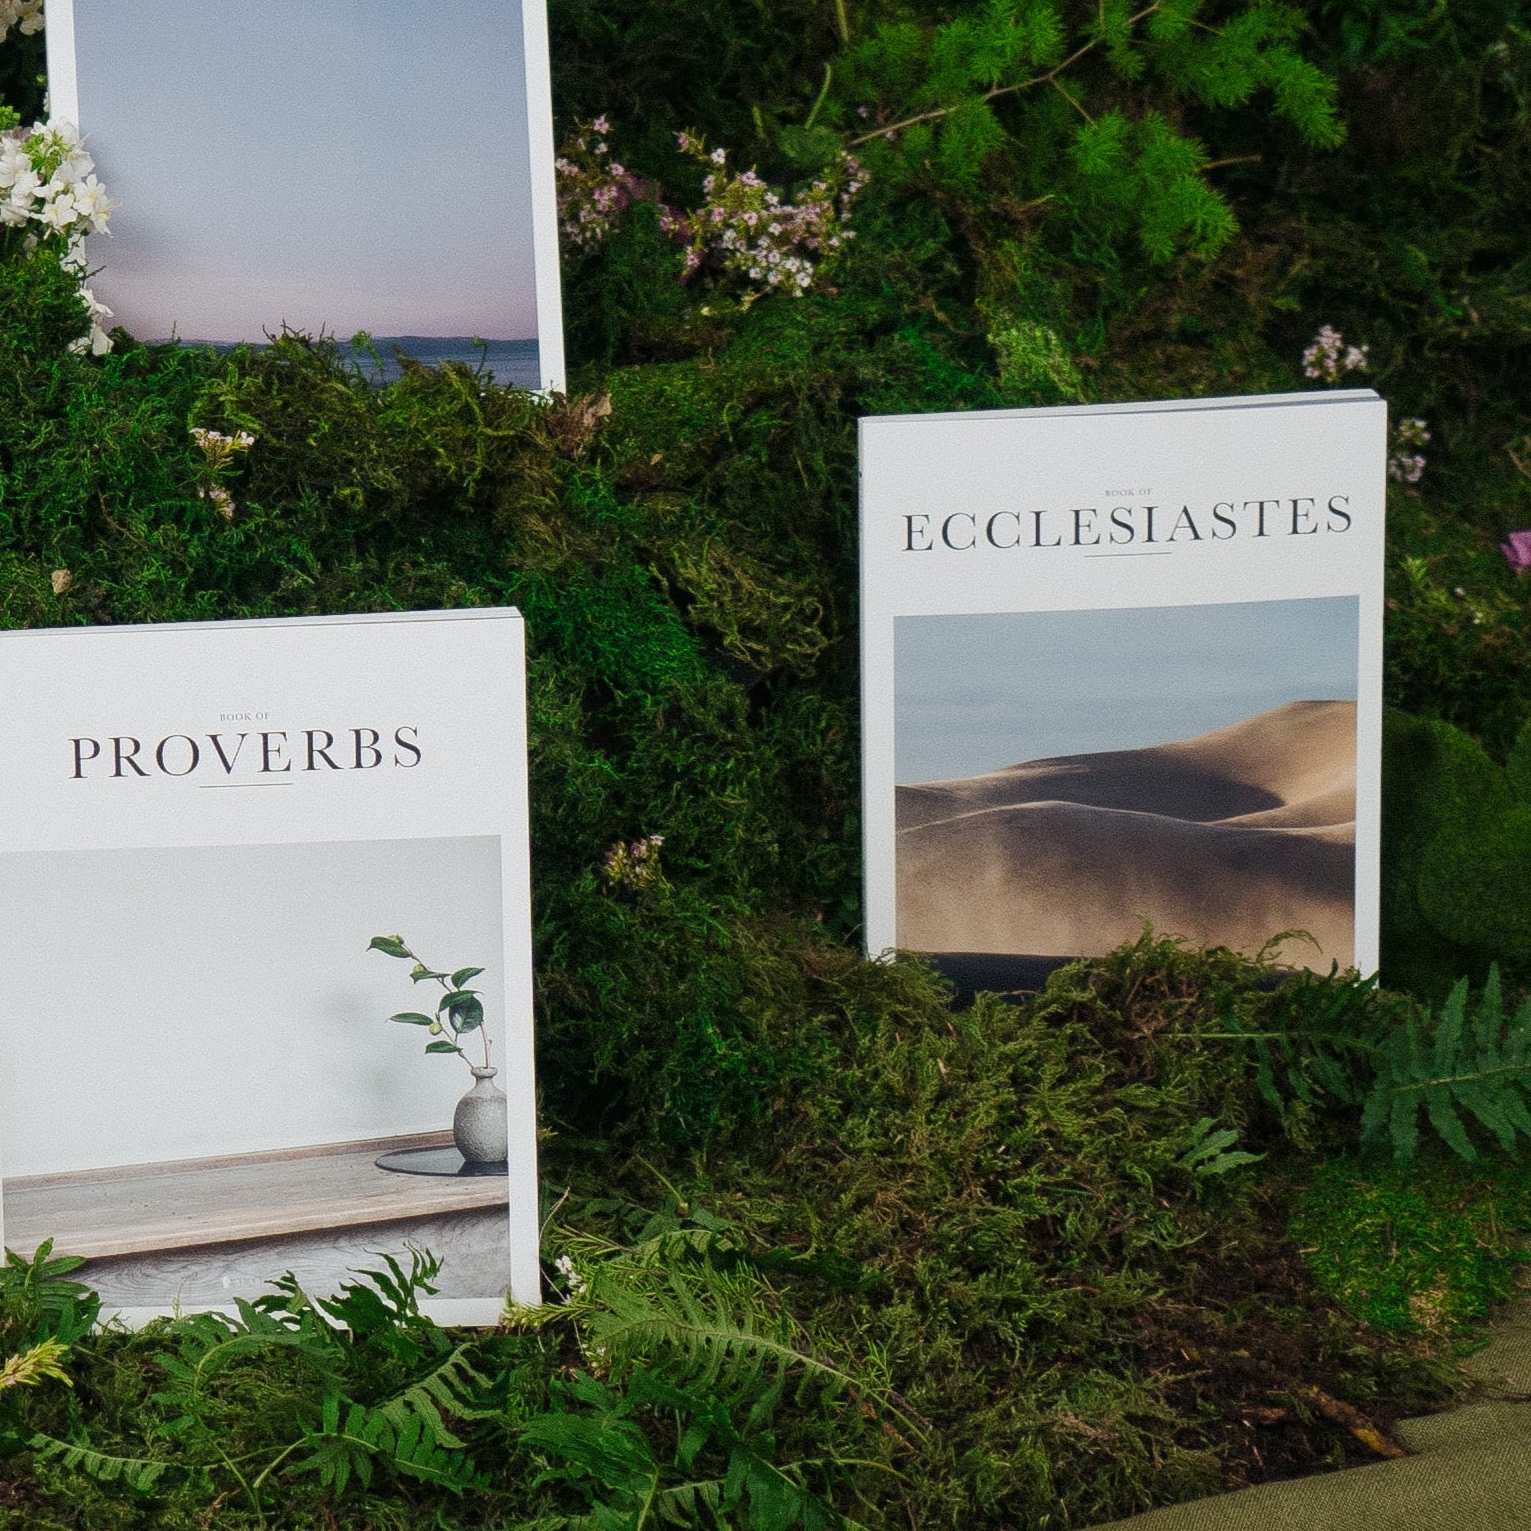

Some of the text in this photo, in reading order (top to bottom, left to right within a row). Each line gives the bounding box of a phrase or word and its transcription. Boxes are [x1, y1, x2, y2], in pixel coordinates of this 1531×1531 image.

[1104, 488, 1153, 498] BOOK OF
[901, 495, 1353, 552] ECCLESIASTES
[219, 711, 270, 722] BOOK OF
[68, 725, 422, 780] PROVERBS
